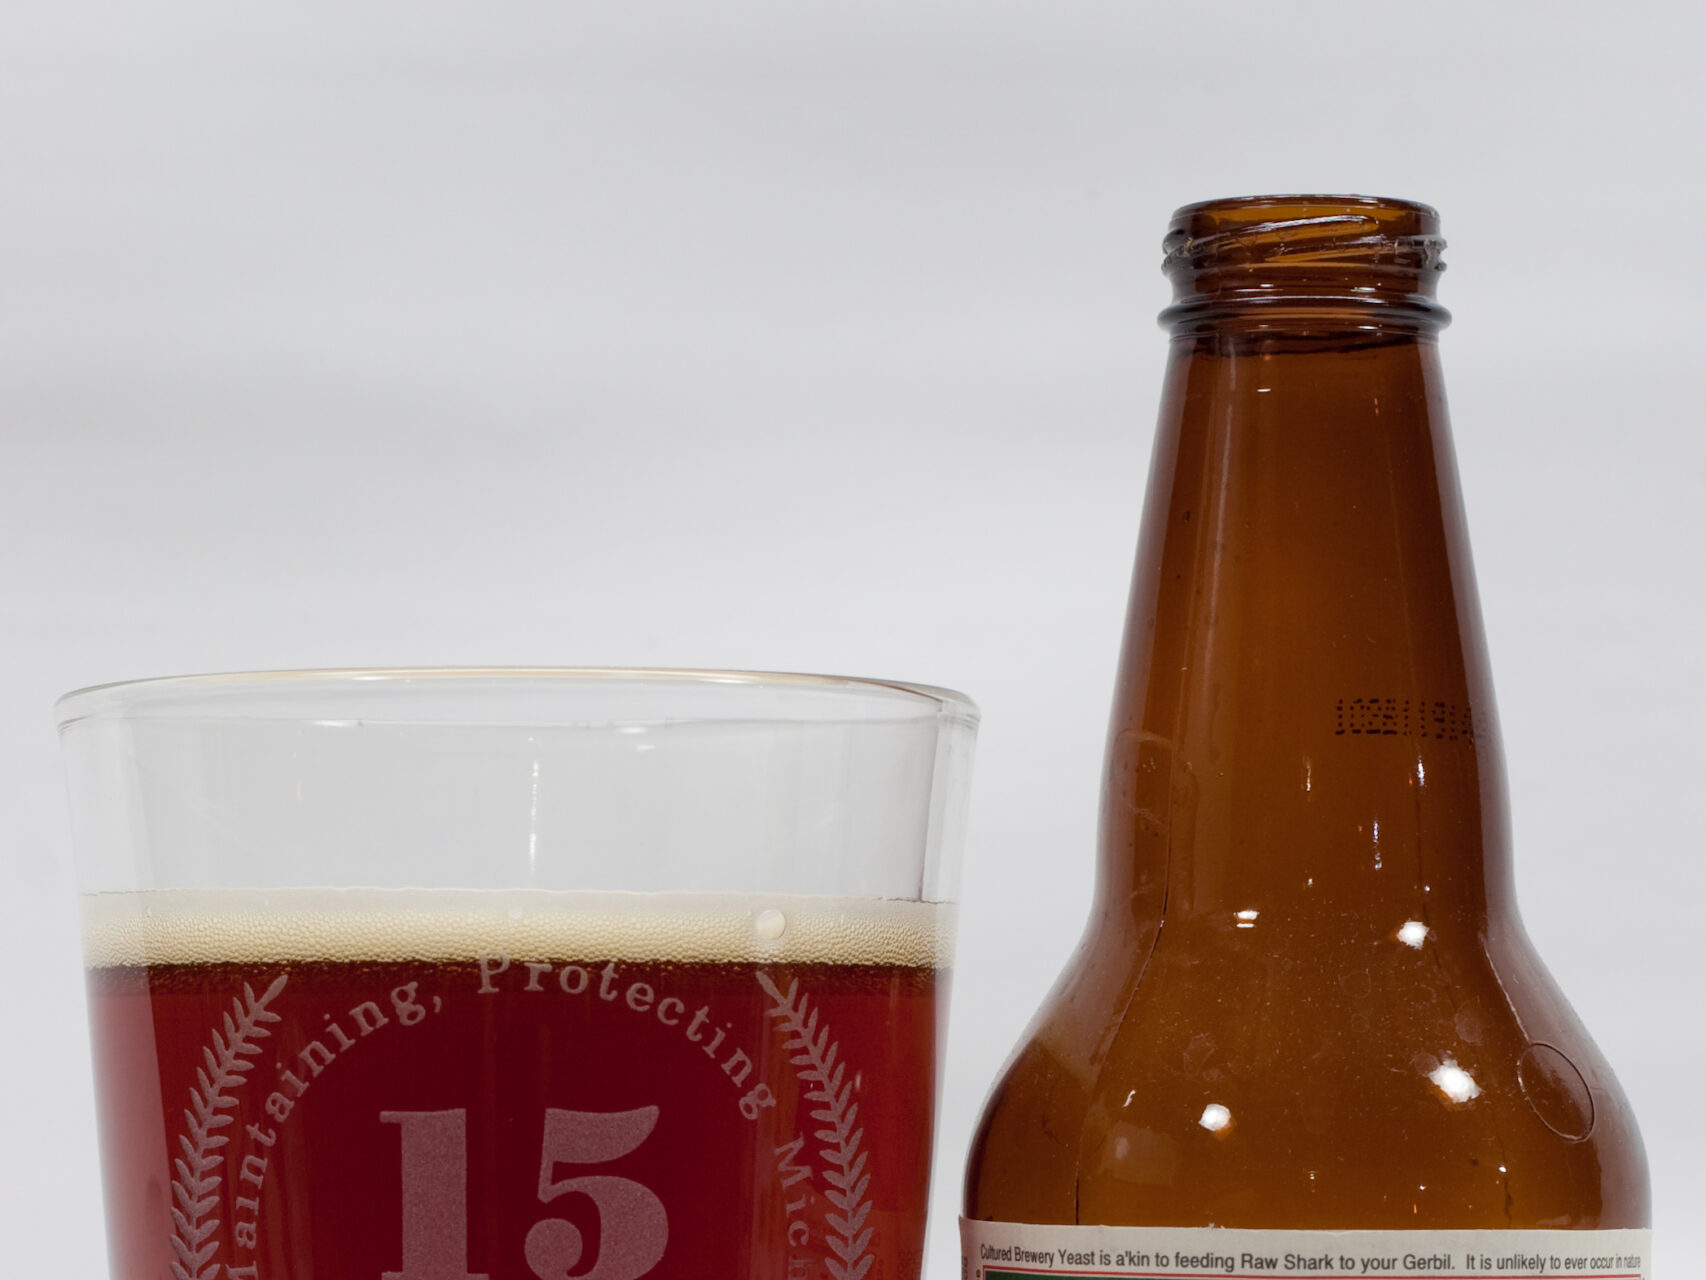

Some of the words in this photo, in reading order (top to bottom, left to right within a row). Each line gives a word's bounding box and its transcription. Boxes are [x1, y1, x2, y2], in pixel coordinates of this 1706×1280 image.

[476, 952, 776, 1121] Protecting
[981, 1244, 1012, 1262] Cultured
[1014, 1246, 1055, 1268] Brewery
[1058, 1249, 1095, 1266] Yeast
[1100, 1250, 1111, 1266] is
[1115, 1251, 1150, 1267] a'kin
[1154, 1252, 1170, 1268] to
[1174, 1251, 1235, 1272] feeding
[1241, 1253, 1278, 1270] Raw
[1283, 1253, 1334, 1270] Shark
[1339, 1254, 1355, 1270] to
[1361, 1256, 1397, 1274] your
[1402, 1253, 1455, 1270] Gerbil.
[1466, 1254, 1476, 1270] It
[1480, 1254, 1492, 1270] is
[1496, 1253, 1546, 1274] unlikely
[1550, 1254, 1562, 1270] to
[1564, 1255, 1588, 1270] ever
[1589, 1255, 1614, 1269] occur
[1615, 1255, 1623, 1269] in
[1623, 1254, 1642, 1269] nature
